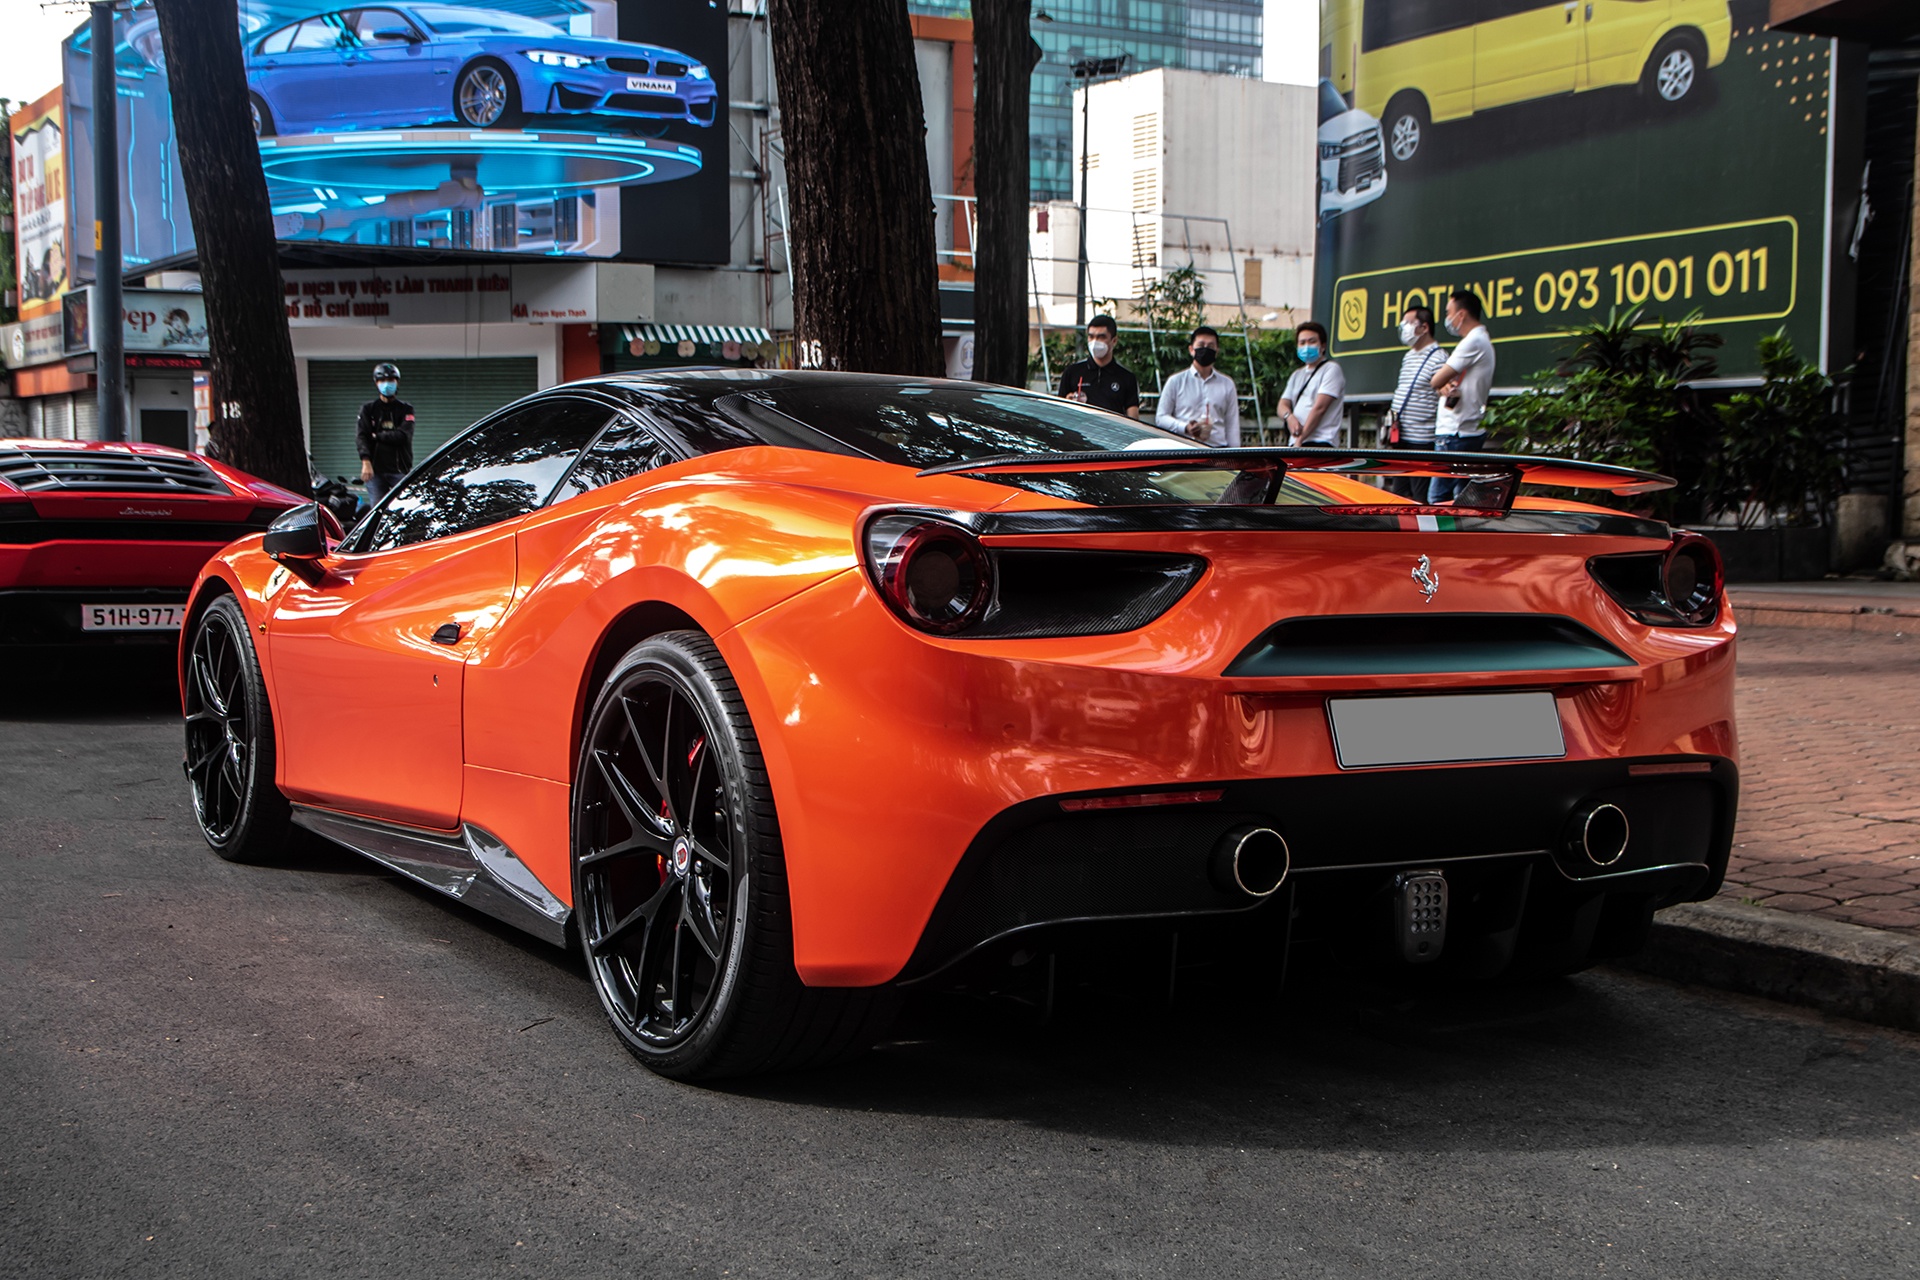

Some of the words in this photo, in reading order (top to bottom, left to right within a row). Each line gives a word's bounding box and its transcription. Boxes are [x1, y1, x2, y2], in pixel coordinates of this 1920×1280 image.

[631, 81, 673, 91] VINAMA
[1382, 277, 1523, 329] HOTNE:
[1533, 267, 1600, 313] 093
[1610, 255, 1694, 305] 1001
[1706, 246, 1768, 296] 011
[512, 303, 528, 318] 4A
[122, 307, 157, 333] ẹp
[801, 339, 823, 368] 16
[221, 401, 241, 419] 18
[93, 608, 187, 626] 51H-977.
